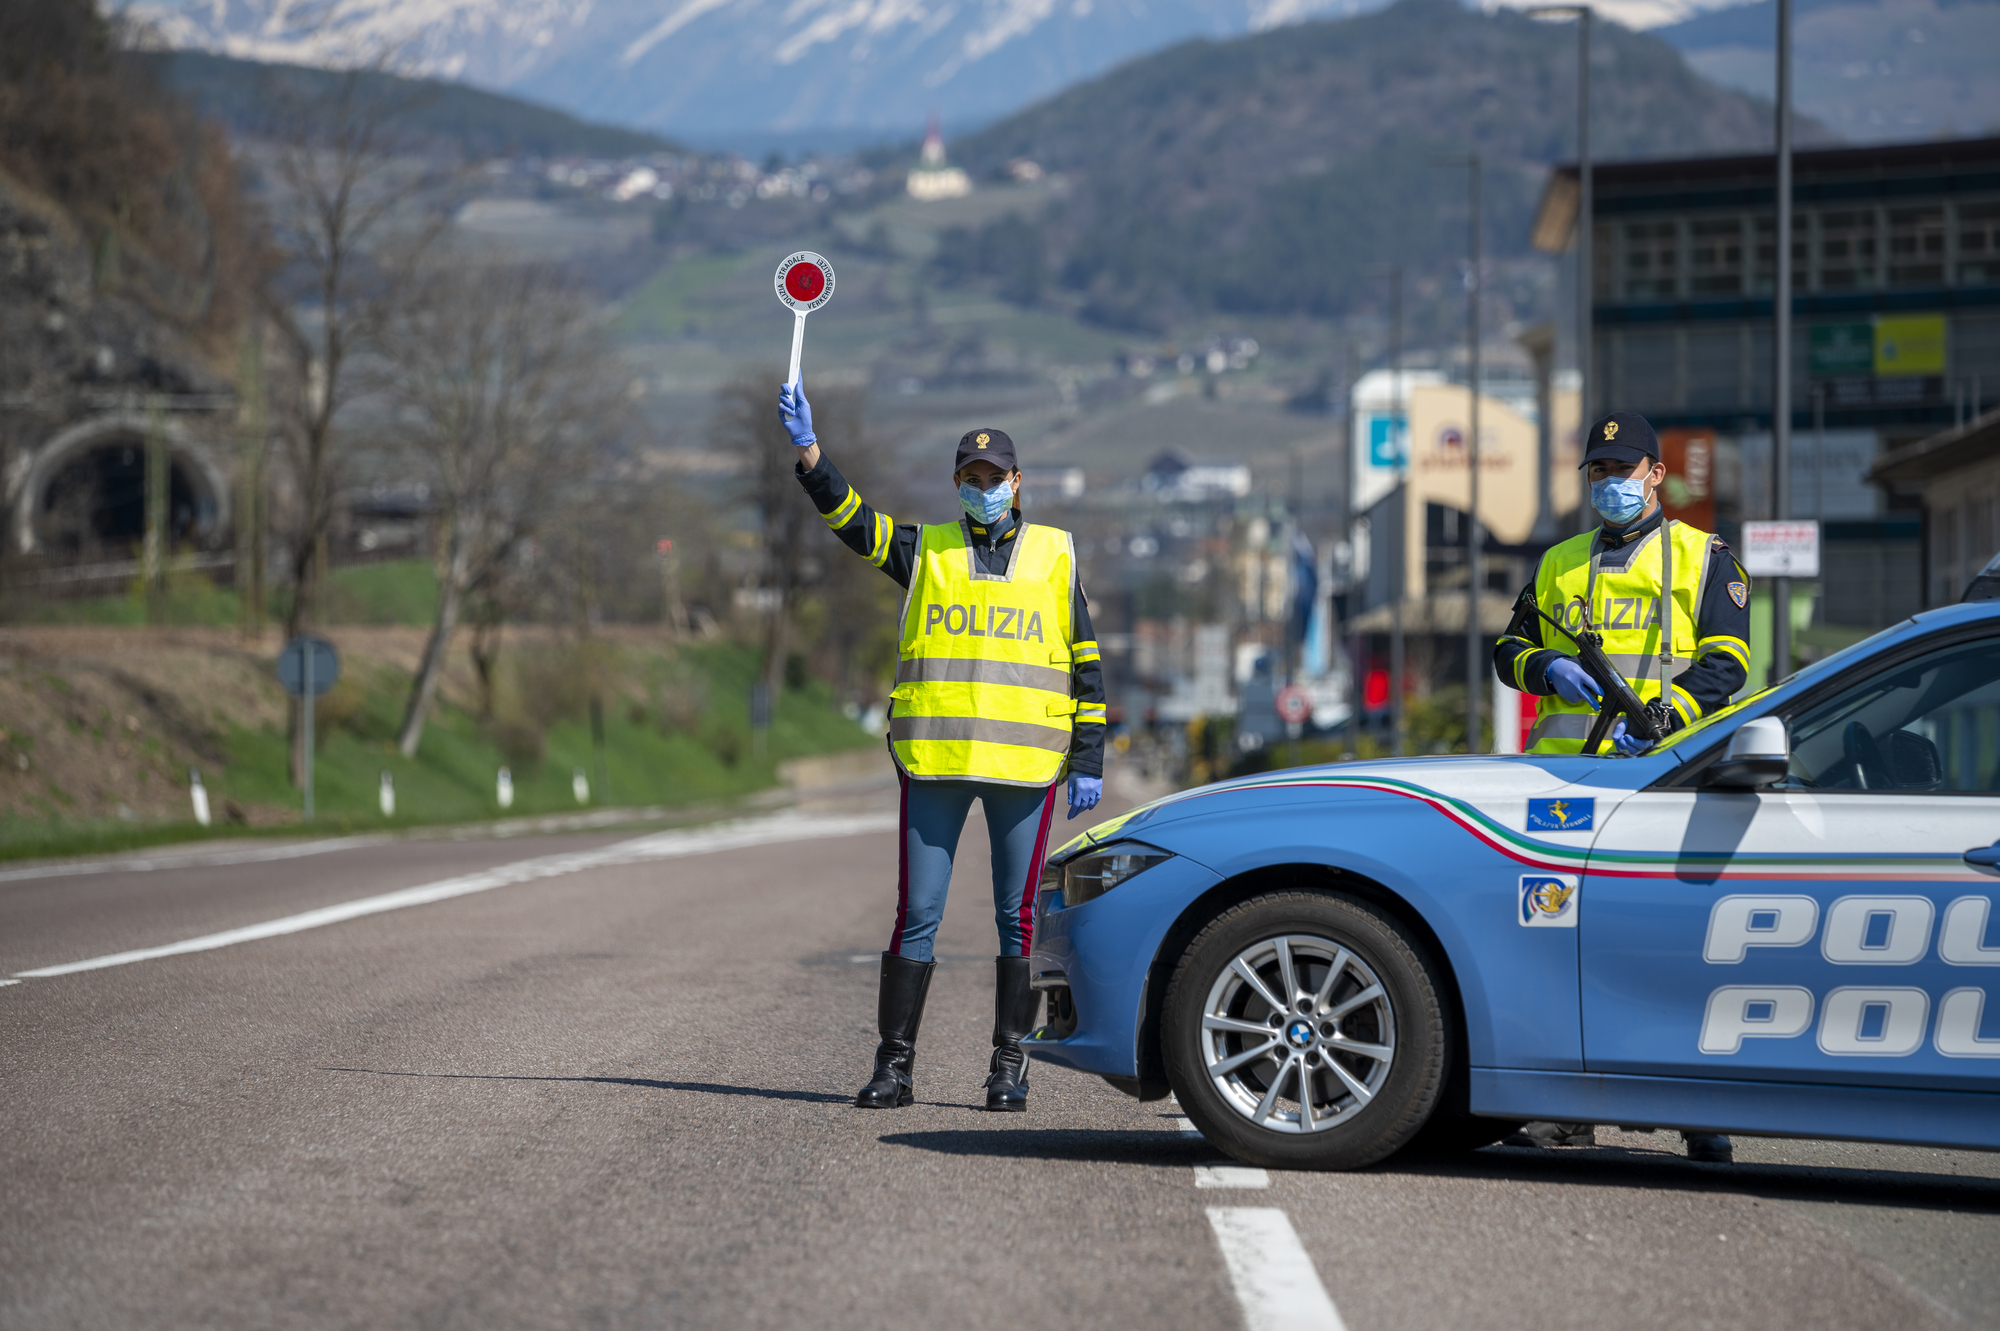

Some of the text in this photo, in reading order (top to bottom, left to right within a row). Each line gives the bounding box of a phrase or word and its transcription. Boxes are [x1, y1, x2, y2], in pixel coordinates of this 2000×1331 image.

[777, 254, 805, 307] POLIZIA STRADALE
[806, 258, 833, 310] VERKEHRSPOLIZEI
[925, 604, 1044, 644] POLIZIA
[1552, 597, 1663, 637] POLIZIA
[1702, 894, 2000, 967] POL
[1697, 984, 2000, 1060] POL
